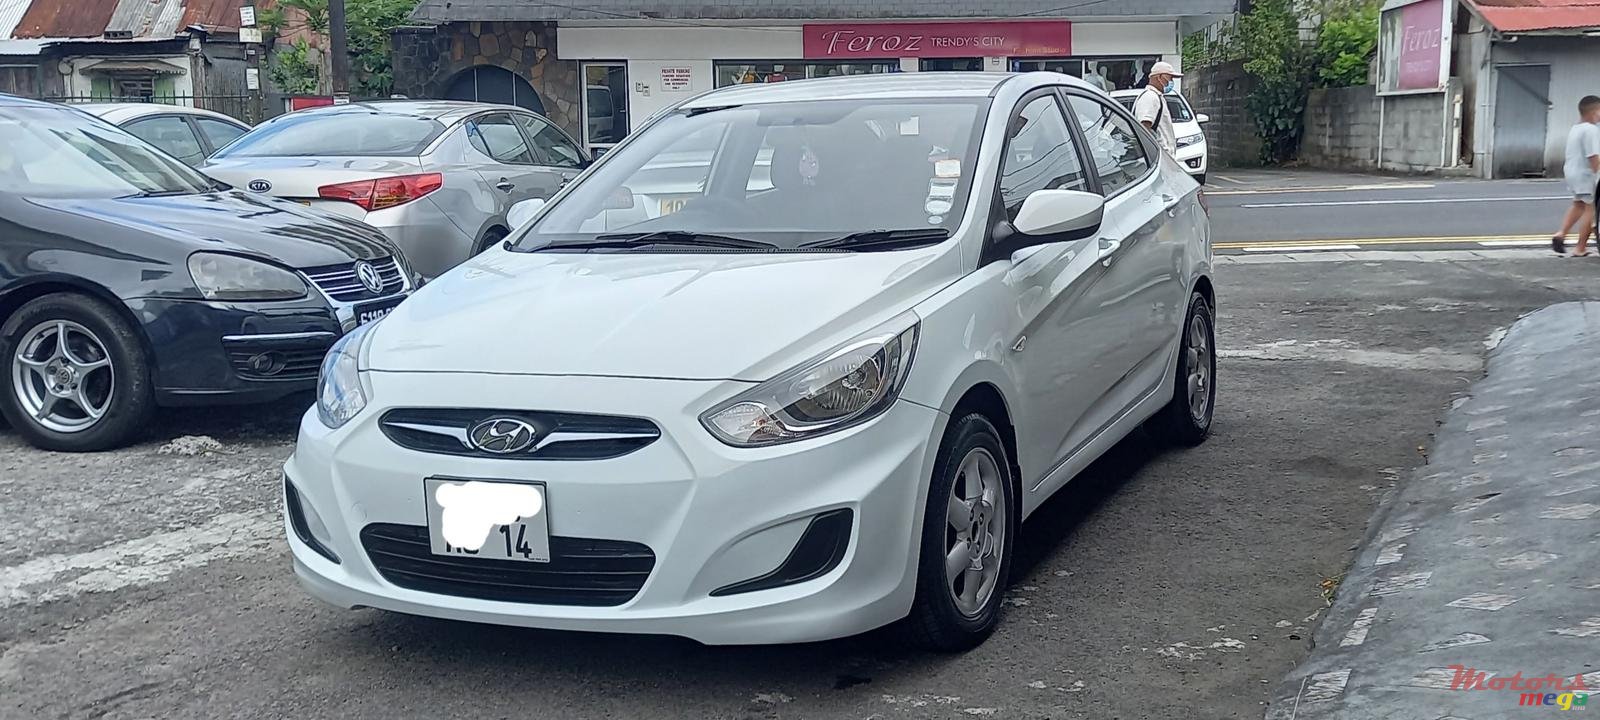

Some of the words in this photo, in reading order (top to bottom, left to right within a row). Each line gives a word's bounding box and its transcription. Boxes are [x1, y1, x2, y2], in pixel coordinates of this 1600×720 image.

[822, 30, 922, 54] Feroz
[930, 37, 979, 47] TRENDY'S
[981, 36, 1005, 47] CITY
[1401, 25, 1440, 57] Feroz
[499, 524, 532, 558] 14
